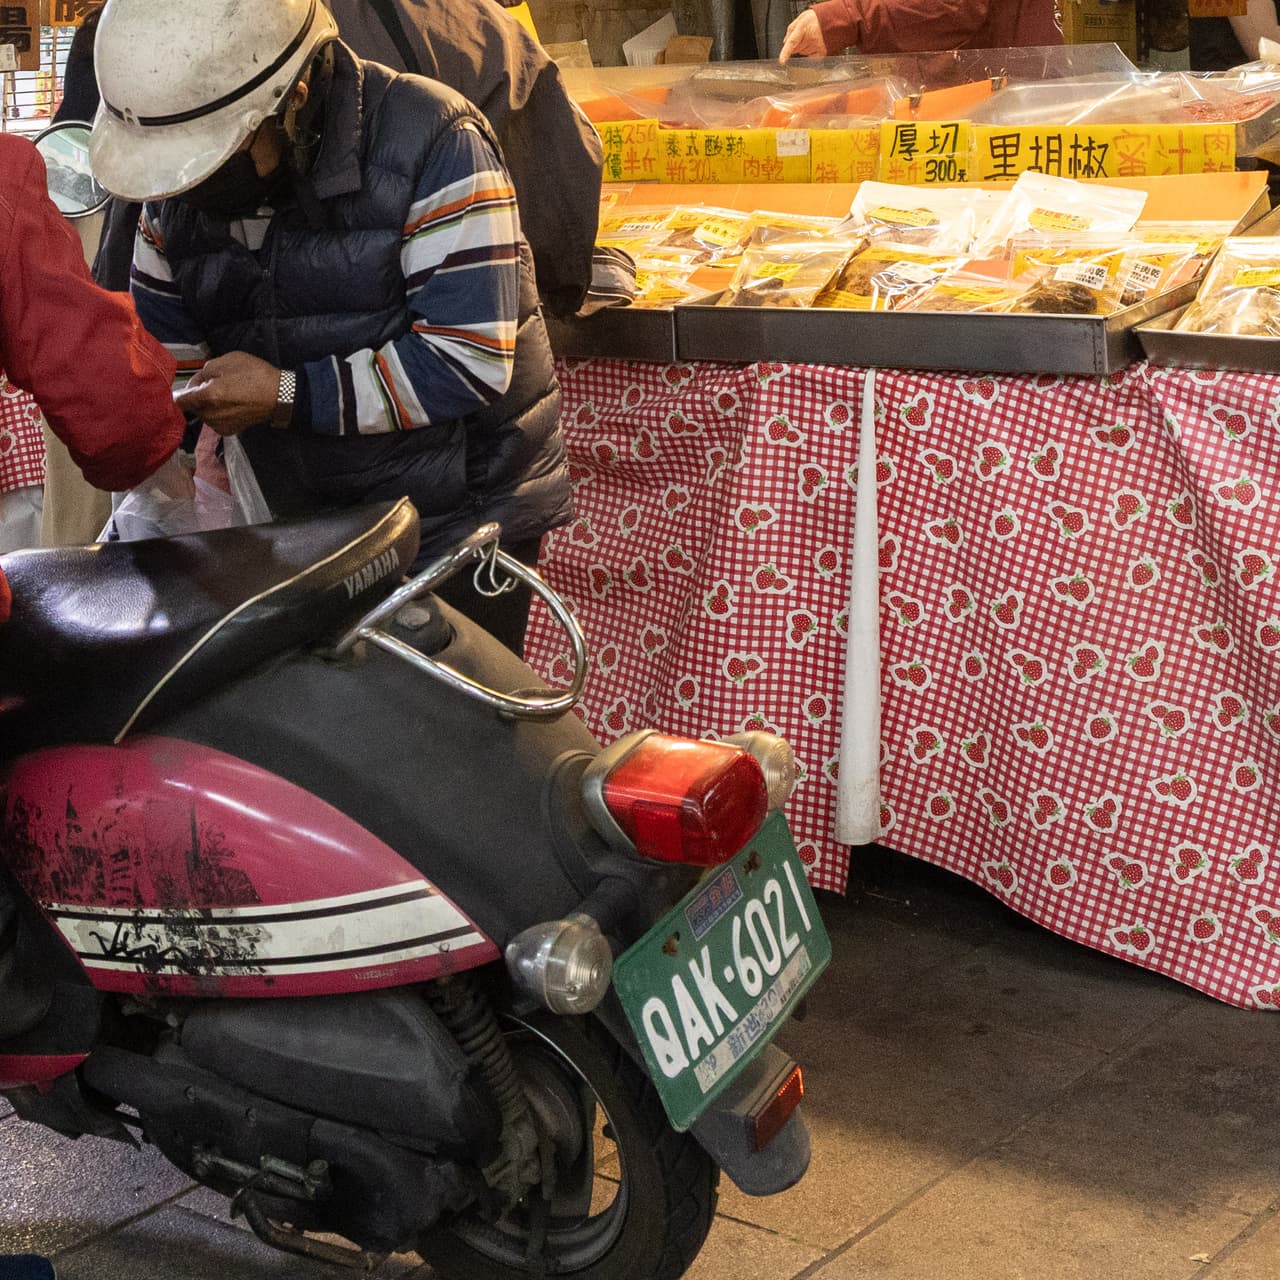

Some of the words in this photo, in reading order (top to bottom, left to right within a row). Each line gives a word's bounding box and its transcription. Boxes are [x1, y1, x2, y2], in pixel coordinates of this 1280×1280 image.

[604, 126, 623, 180] 特價
[889, 122, 960, 162] 厚切
[343, 546, 401, 600] YAMAHA
